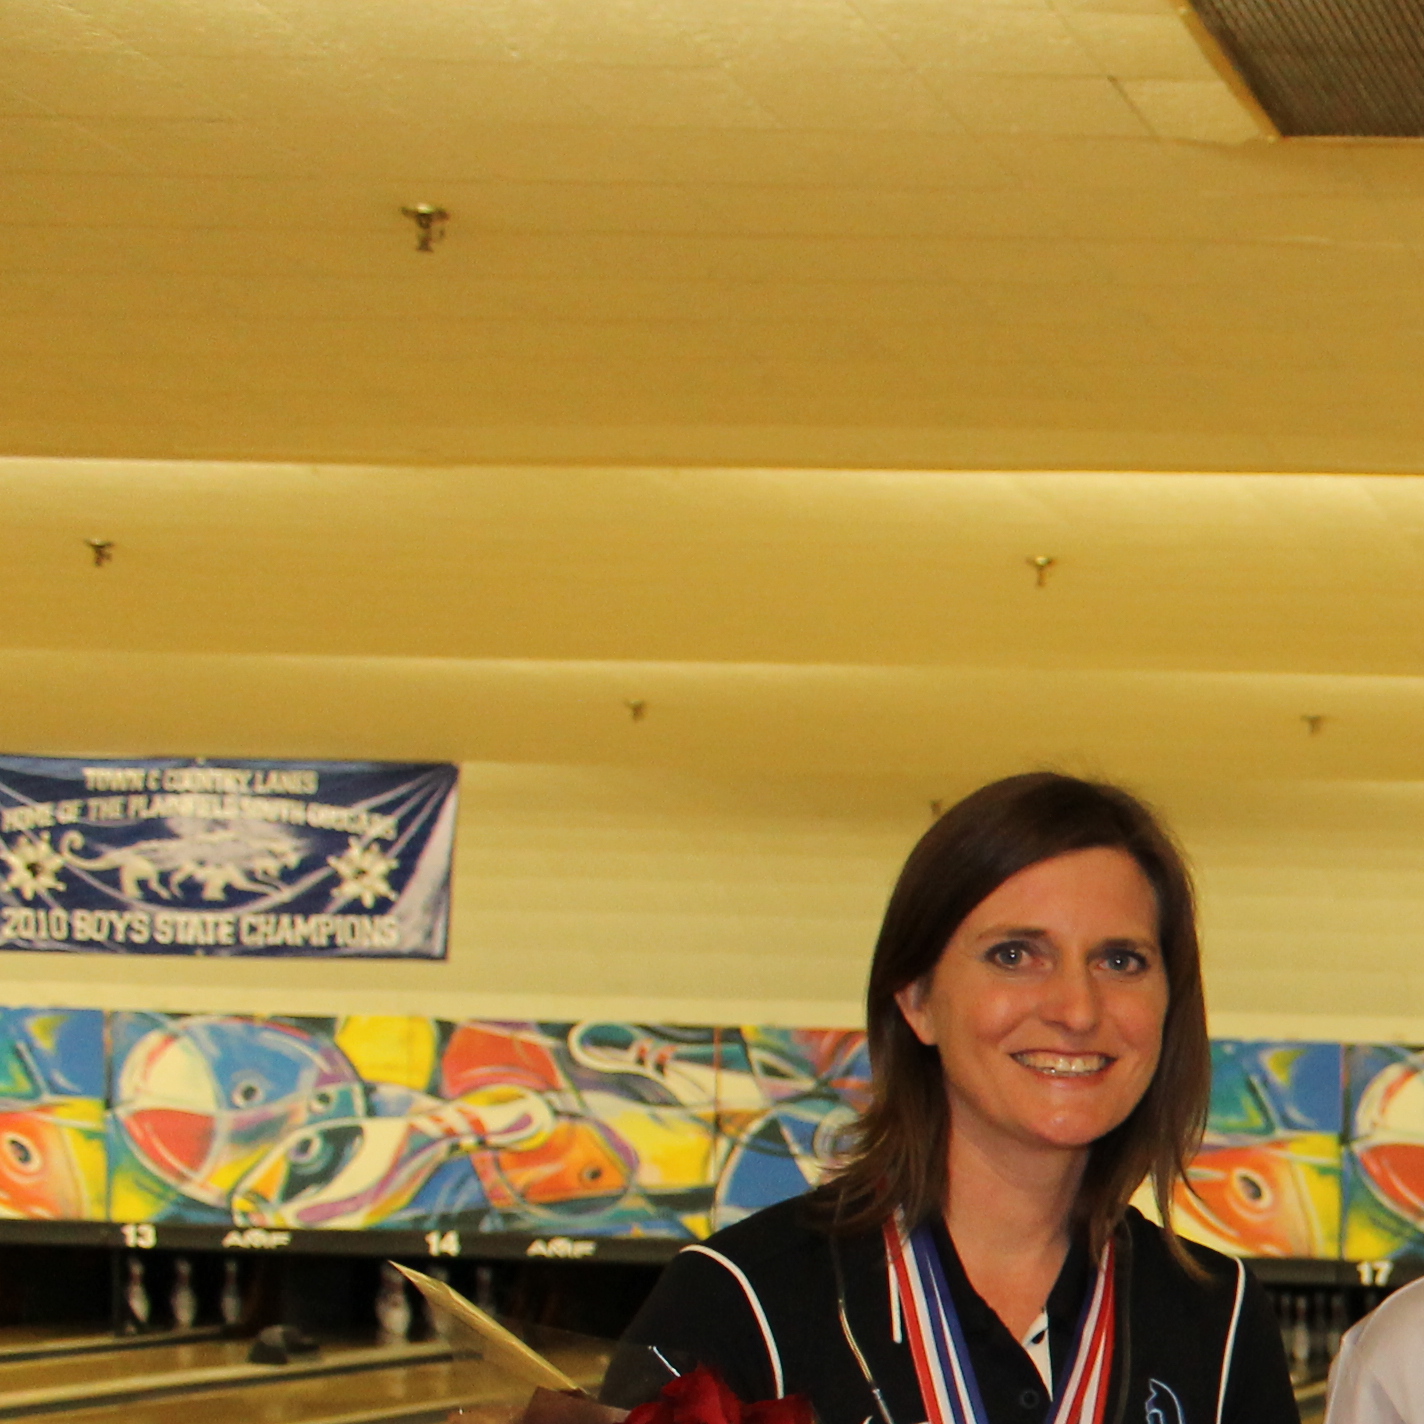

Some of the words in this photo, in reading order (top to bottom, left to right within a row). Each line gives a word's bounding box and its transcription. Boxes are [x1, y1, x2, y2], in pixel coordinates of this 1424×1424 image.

[1, 907, 69, 940] 2010
[71, 911, 151, 943] BOYS
[153, 914, 236, 946] STATE
[239, 914, 400, 948] CHAMPIONS
[122, 1224, 156, 1249] 13
[222, 1228, 291, 1249] AMF
[426, 1230, 461, 1257] 14
[526, 1236, 597, 1258] AMF
[1356, 1261, 1394, 1286] 17
